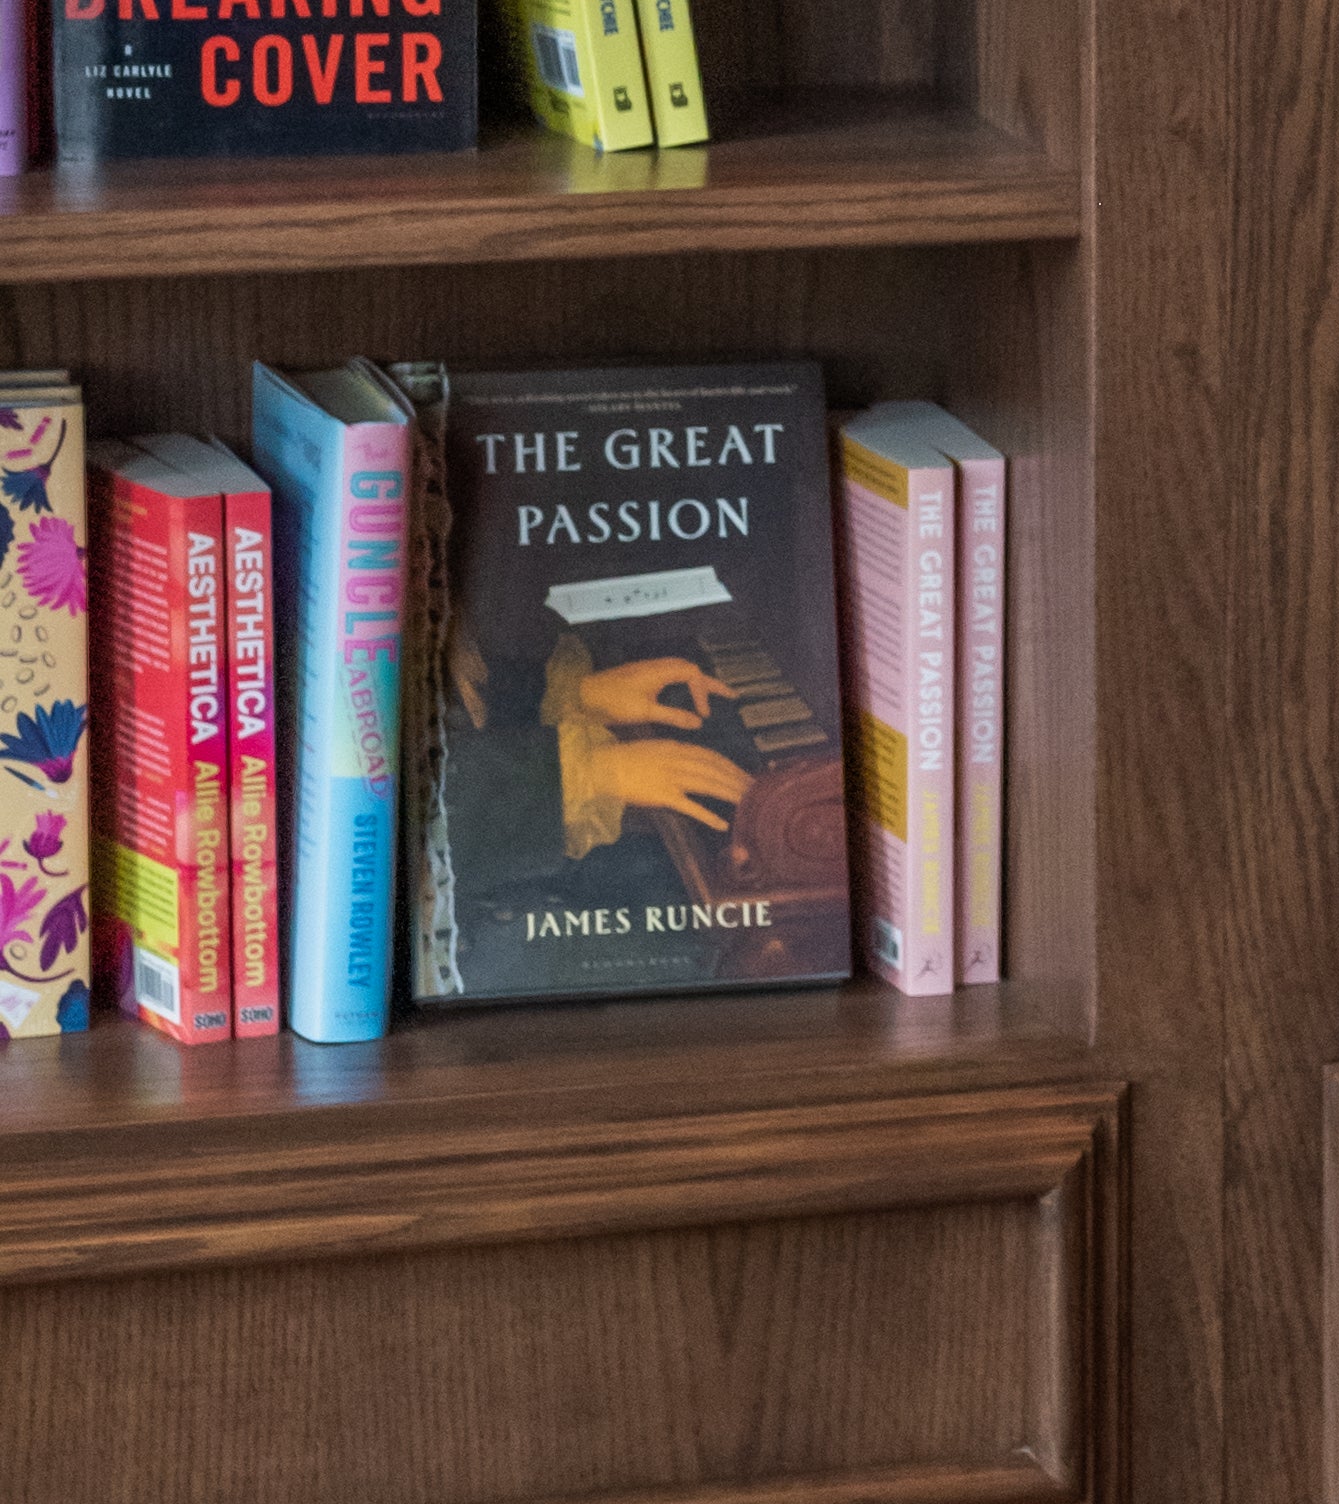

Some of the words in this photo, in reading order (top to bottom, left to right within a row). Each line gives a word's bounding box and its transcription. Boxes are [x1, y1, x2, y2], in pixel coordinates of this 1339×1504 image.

[107, 87, 151, 100] NOVEL
[113, 64, 172, 78] CARLYLE
[201, 32, 444, 108] COVER
[476, 430, 582, 475] THE
[604, 424, 785, 469] GREAT
[517, 496, 751, 546] PASSION
[919, 490, 943, 539] THE
[345, 468, 400, 668] GUNCLE
[919, 550, 943, 640] GREAT
[235, 526, 267, 740] AESTHETICA
[346, 667, 392, 800] ABROAD
[918, 649, 943, 771] PASSION
[241, 757, 267, 818] Allie
[352, 814, 378, 887] STEVEN
[242, 824, 268, 987] Rowbottom
[347, 895, 375, 989] ROWLEY
[526, 907, 632, 942] JAMES
[645, 900, 772, 933] RUNCIE
